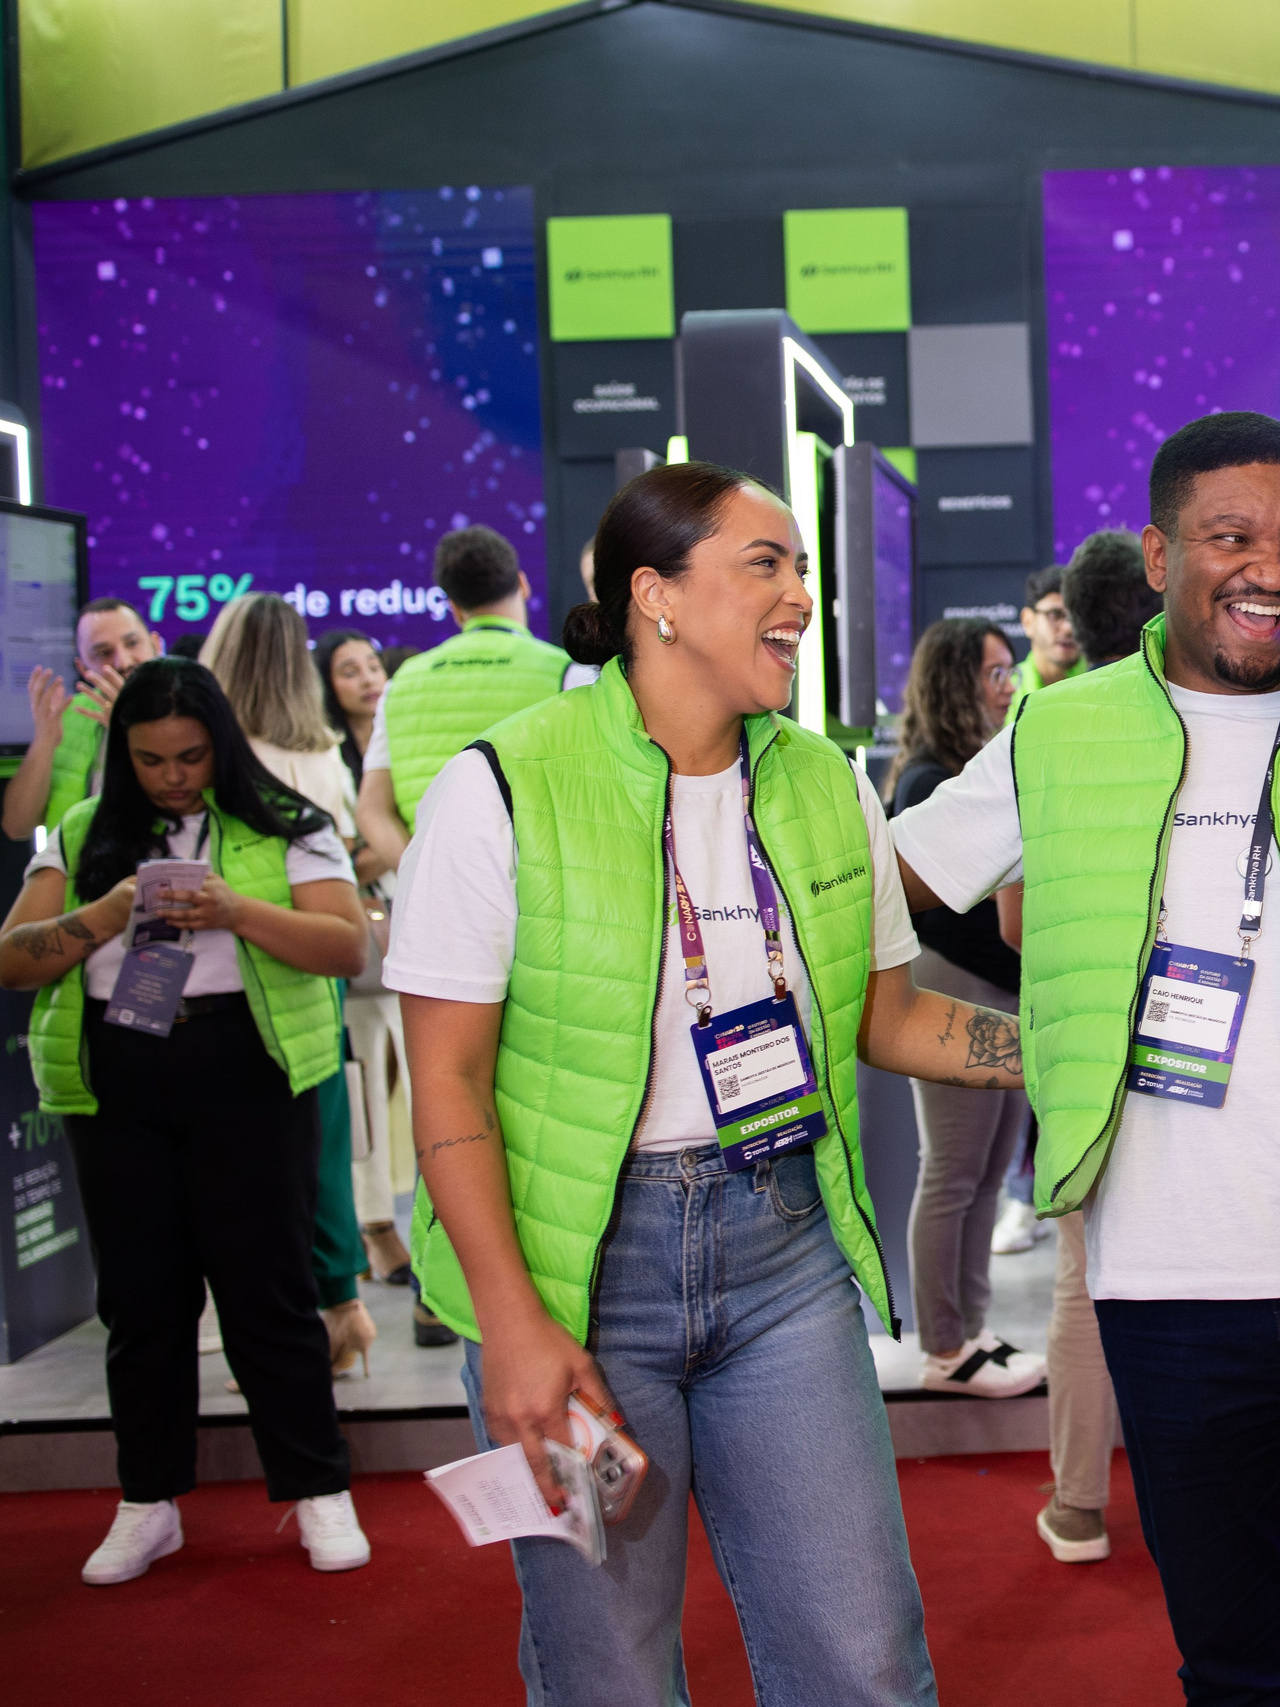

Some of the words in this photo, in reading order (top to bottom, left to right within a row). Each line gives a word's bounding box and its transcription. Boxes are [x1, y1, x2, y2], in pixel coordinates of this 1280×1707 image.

[138, 573, 255, 622] 75%
[282, 582, 330, 618] de
[340, 579, 453, 621] reduç
[1173, 812, 1258, 829] Sankhya
[1252, 845, 1263, 861] RH
[853, 866, 866, 879] RH
[693, 904, 761, 923] Sankhy
[1152, 989, 1170, 998] CAIO
[1170, 993, 1204, 1005] HENRIQUE
[712, 1054, 740, 1068] MARAIS
[740, 1041, 775, 1058] MONTEIRO
[776, 1036, 791, 1046] DOS
[714, 1061, 742, 1076] SANTOS
[1146, 1053, 1207, 1074] EXPOSITOR
[740, 1106, 800, 1135] EXPOSITOR
